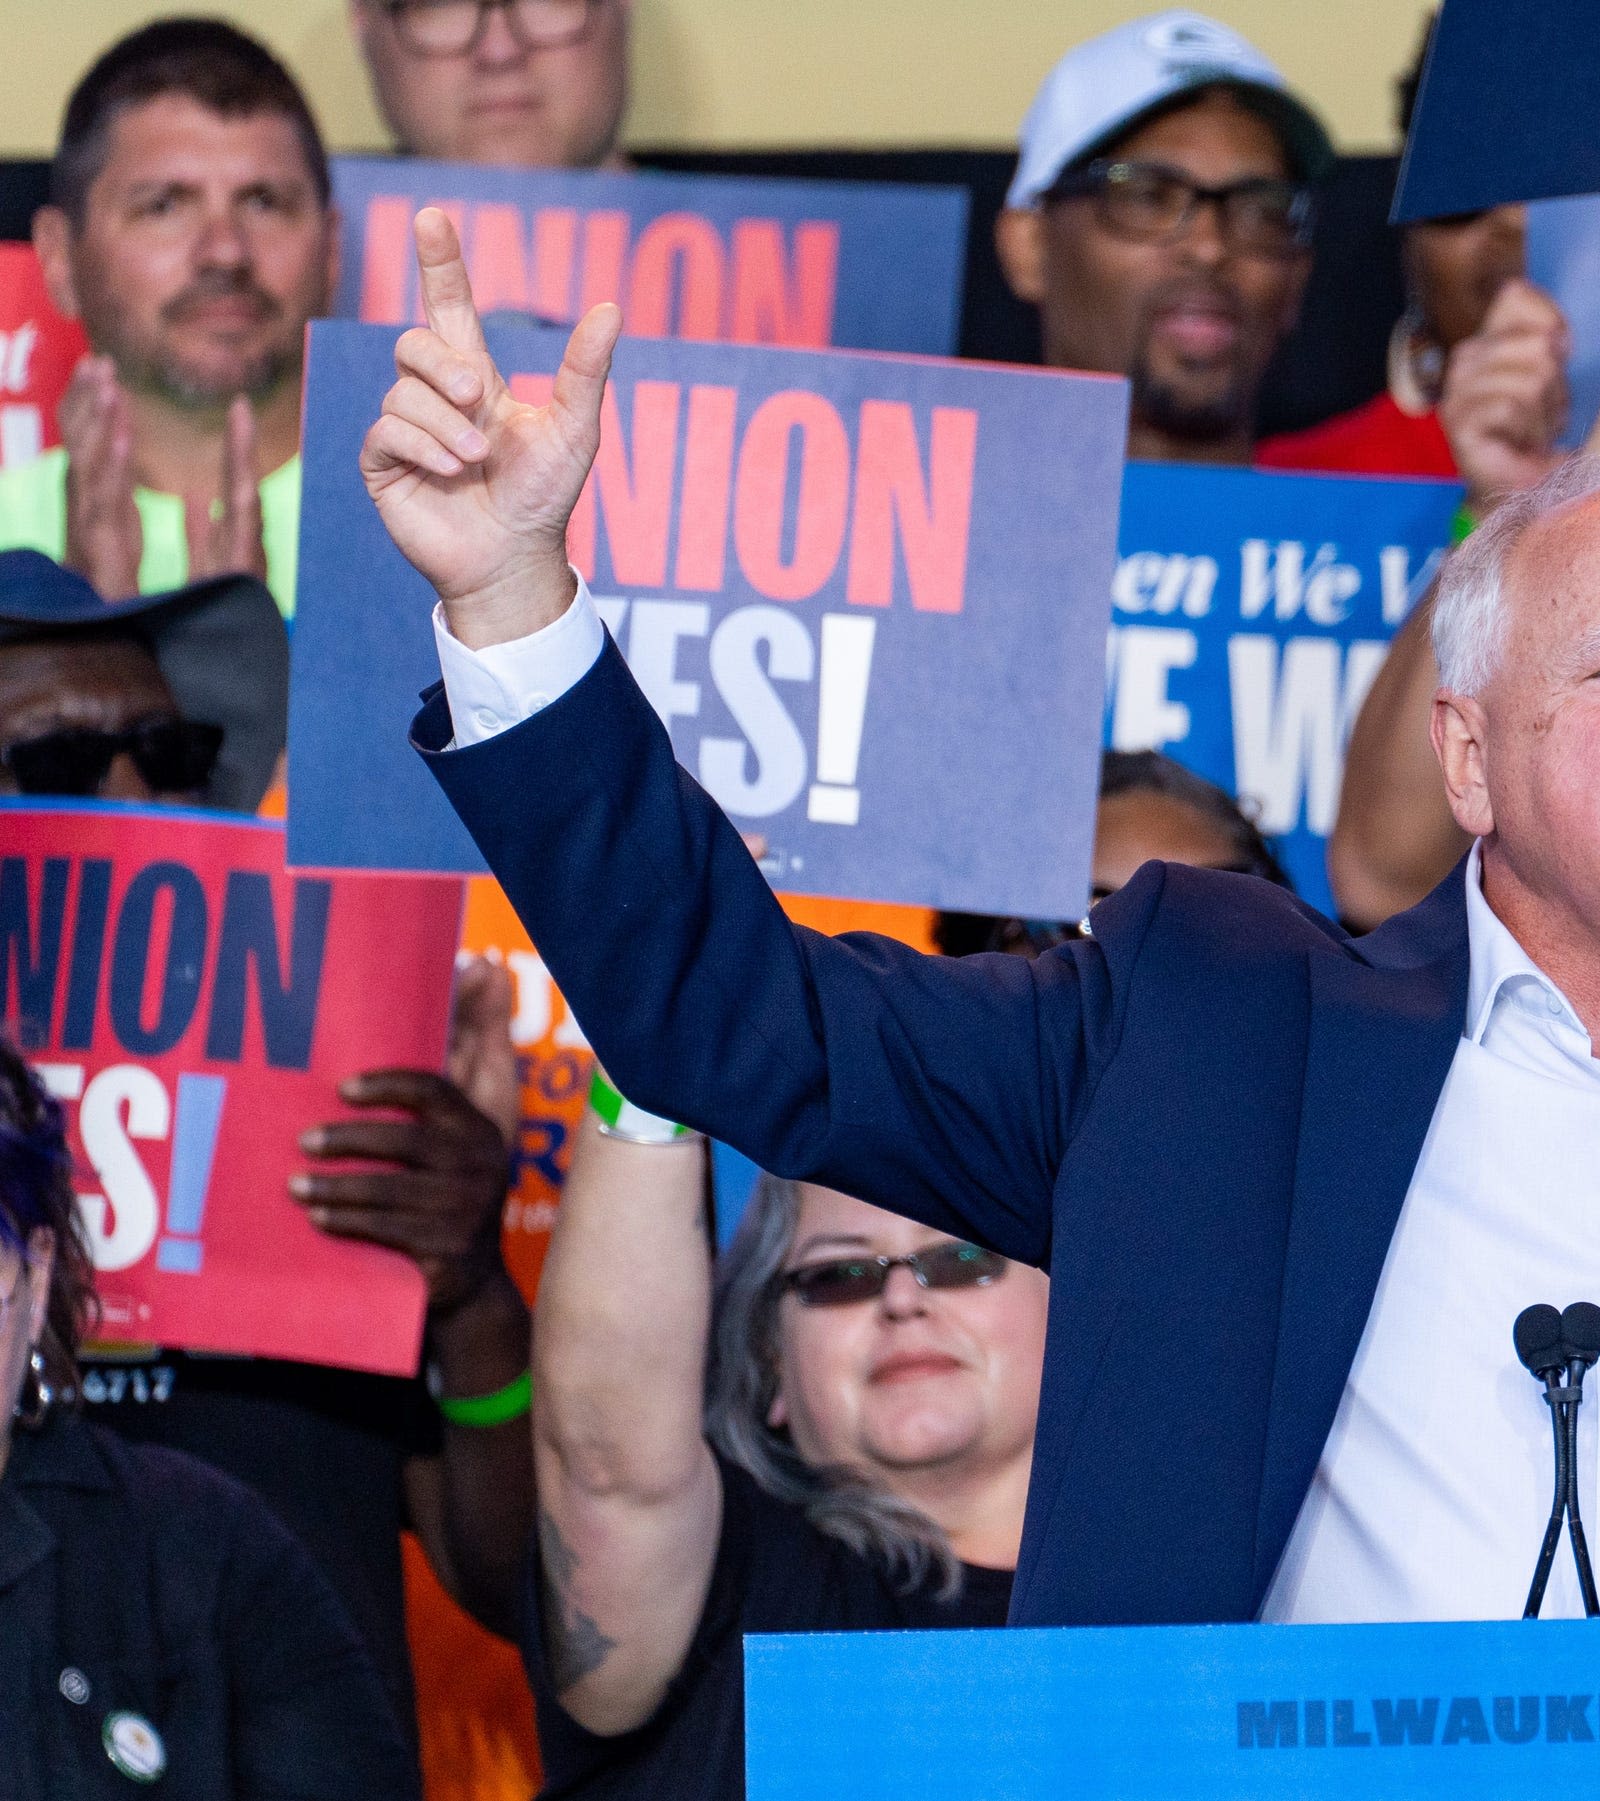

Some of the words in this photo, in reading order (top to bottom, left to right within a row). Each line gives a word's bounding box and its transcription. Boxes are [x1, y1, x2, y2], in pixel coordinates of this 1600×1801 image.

[508, 373, 979, 614] NION
[1239, 538, 1362, 627] We
[588, 594, 877, 826] ES!
[1098, 622, 1198, 752] E
